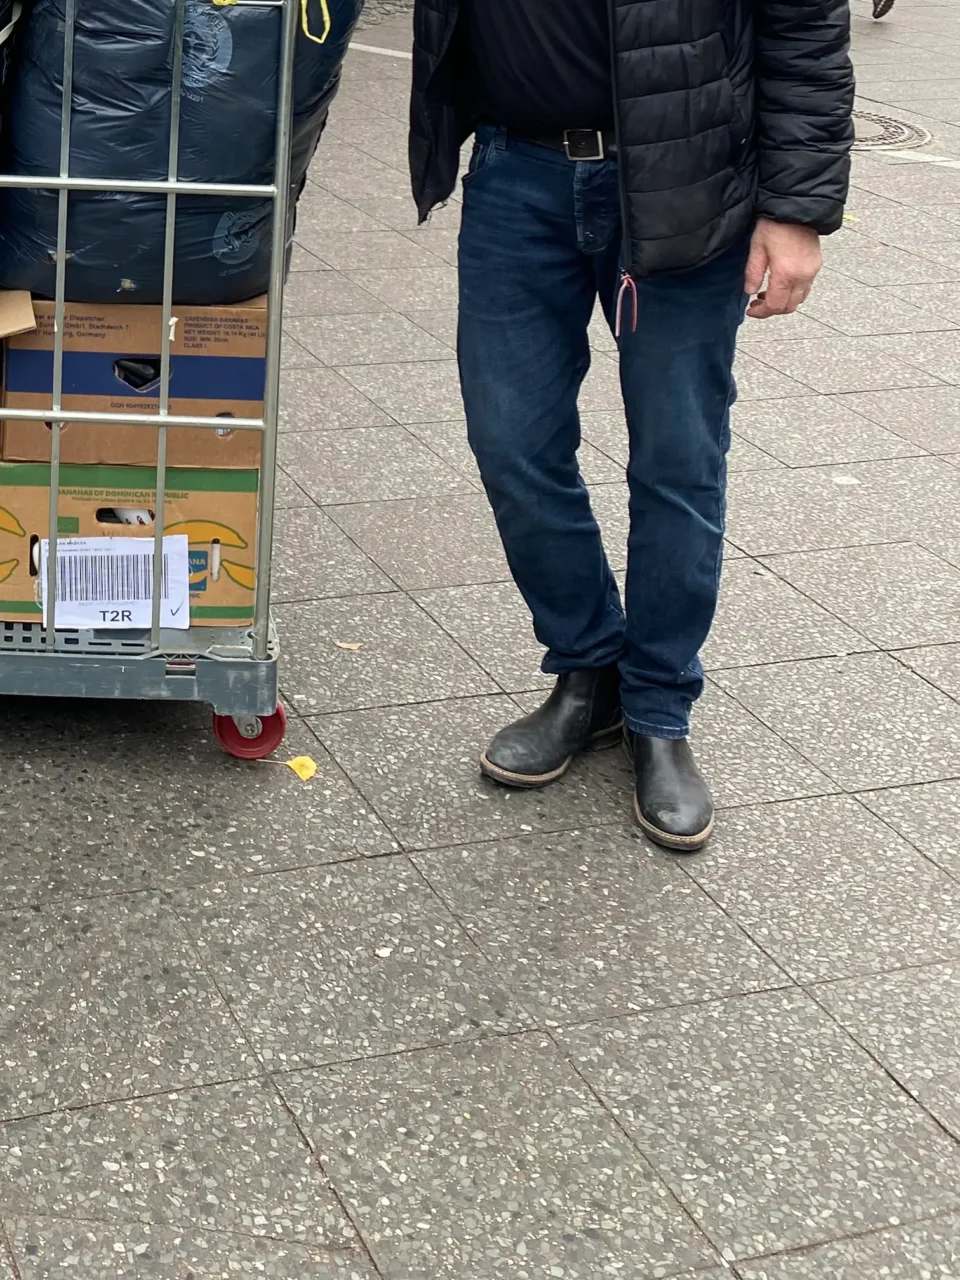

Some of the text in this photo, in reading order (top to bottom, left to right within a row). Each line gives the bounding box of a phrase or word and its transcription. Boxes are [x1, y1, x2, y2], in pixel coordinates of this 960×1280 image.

[76, 331, 106, 339] Germany
[105, 490, 151, 498] DOMINICAN
[99, 609, 133, 623] T2R
